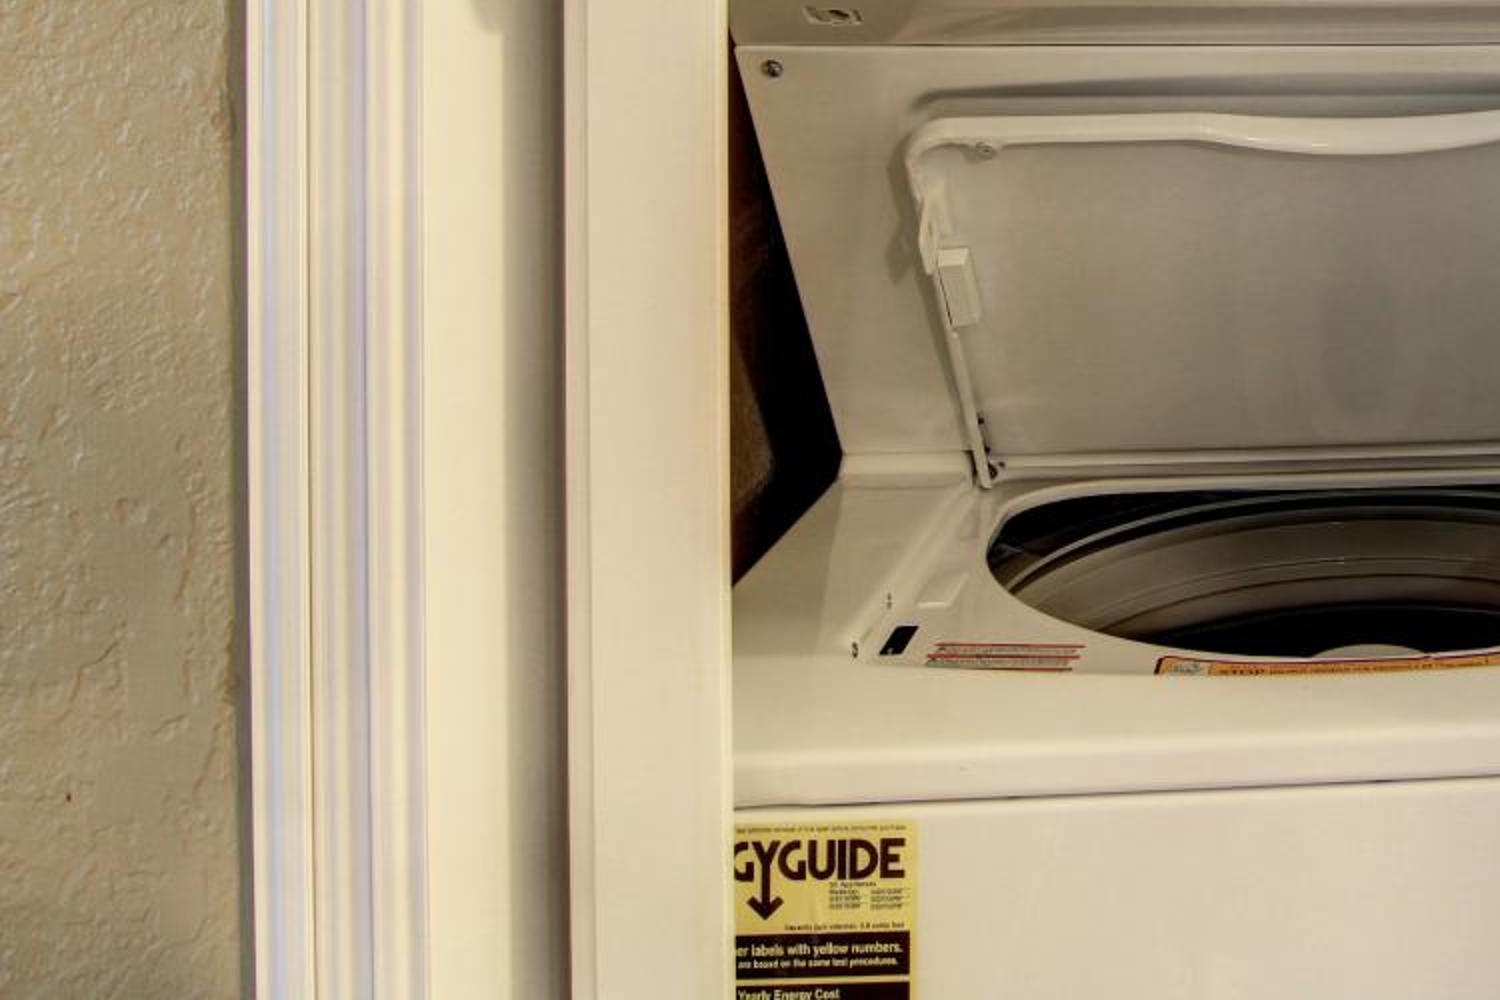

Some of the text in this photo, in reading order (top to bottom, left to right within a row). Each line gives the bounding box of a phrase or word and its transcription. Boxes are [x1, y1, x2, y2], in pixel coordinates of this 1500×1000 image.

[734, 838, 906, 882] GYGUIDE
[751, 944, 785, 957] labels
[786, 942, 811, 955] with
[813, 941, 849, 957] yellow
[851, 940, 904, 954] numbers.
[753, 958, 779, 969] based
[808, 959, 831, 968] same
[832, 957, 848, 967] test
[737, 988, 841, 1000] Yearly Energy Cost
